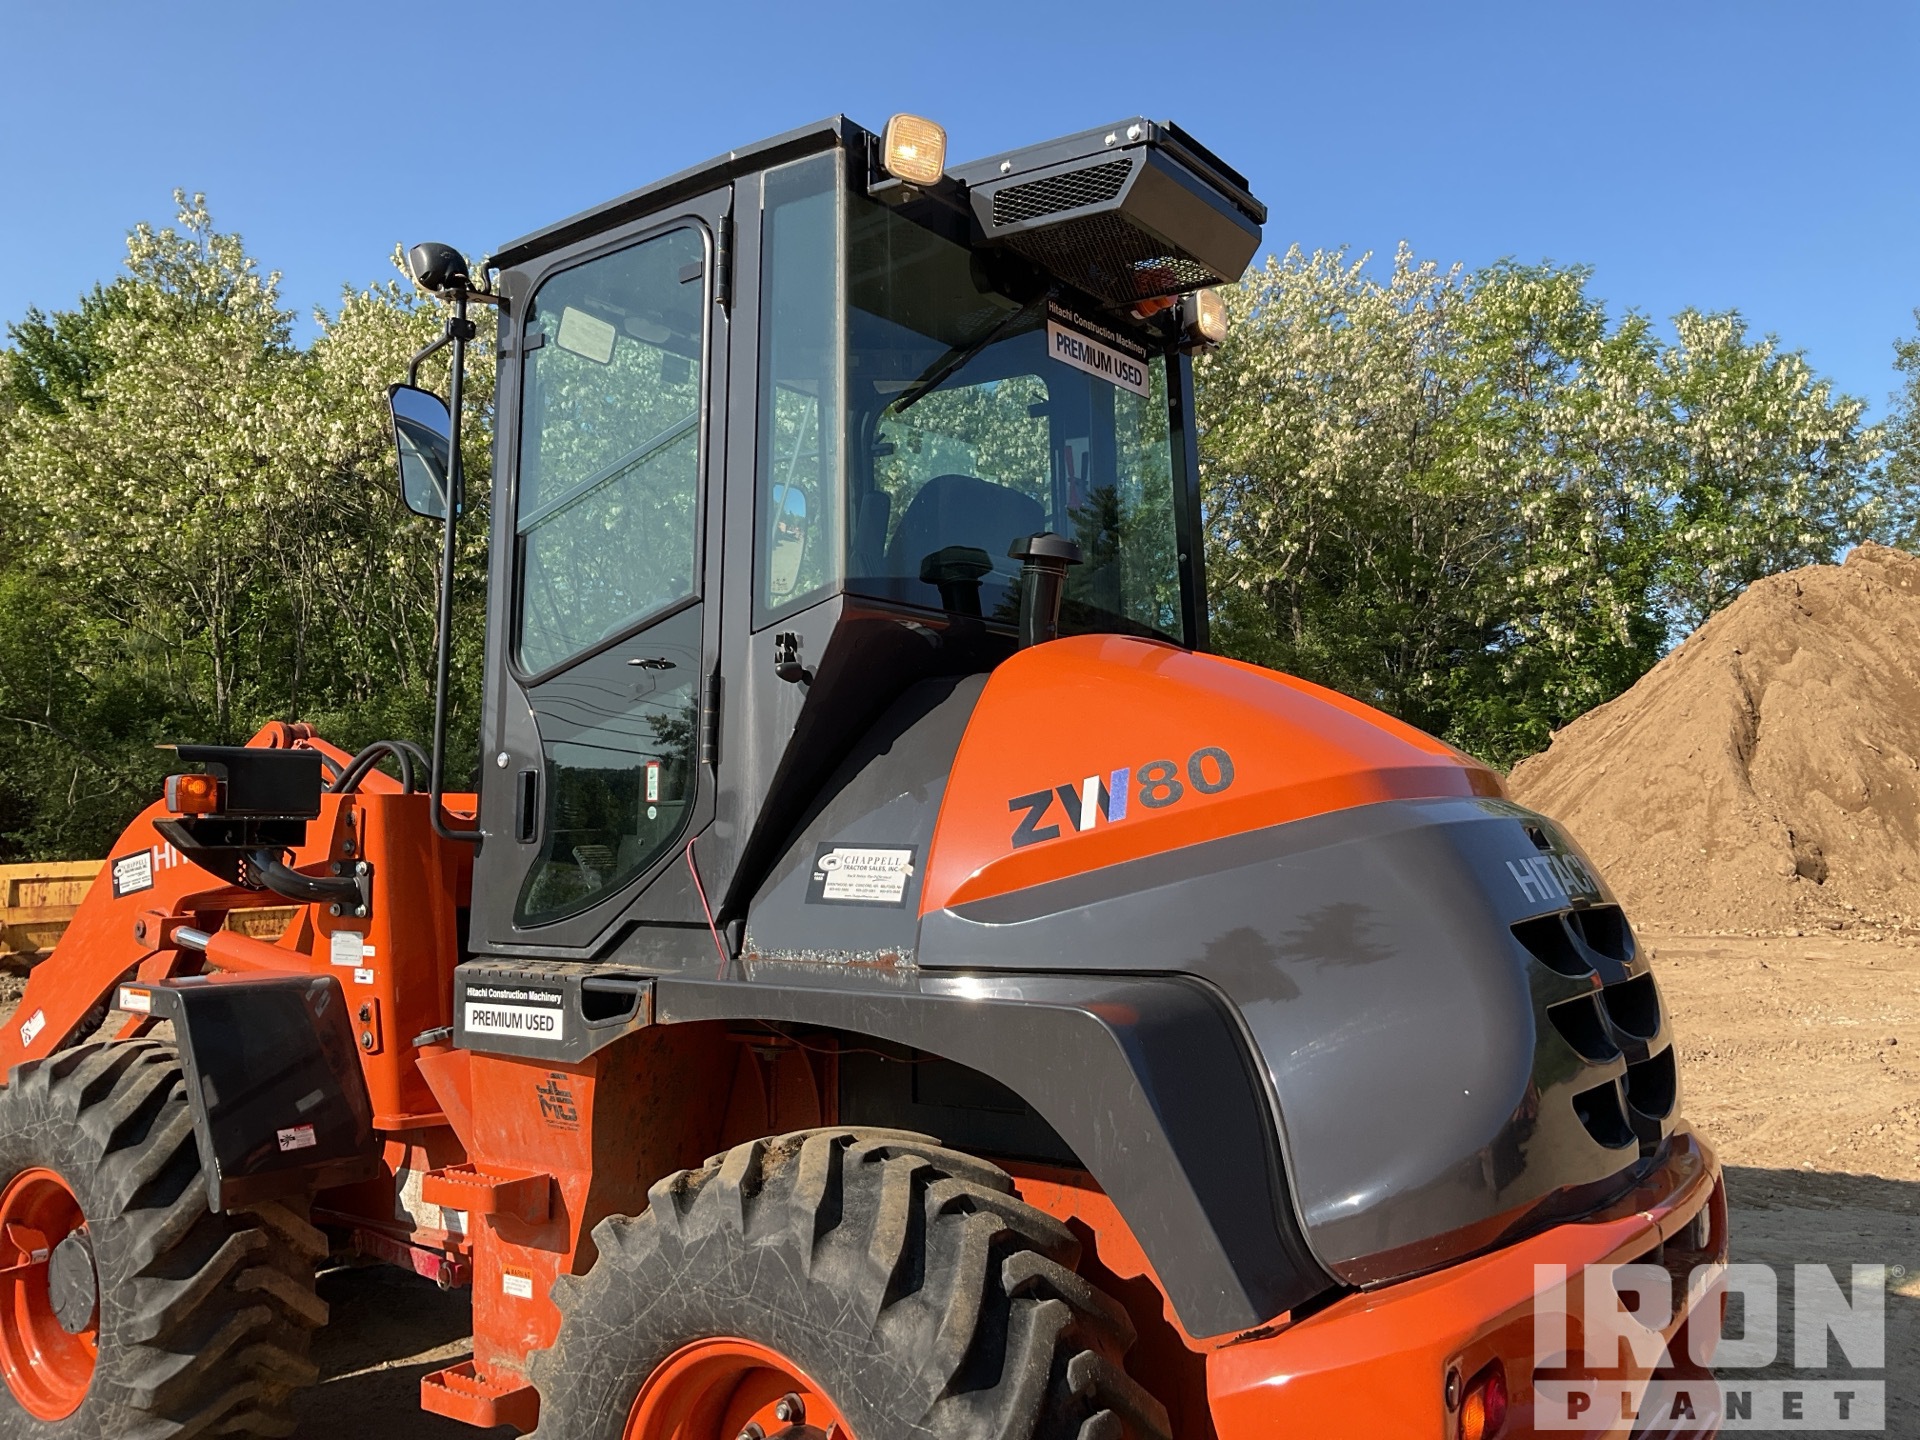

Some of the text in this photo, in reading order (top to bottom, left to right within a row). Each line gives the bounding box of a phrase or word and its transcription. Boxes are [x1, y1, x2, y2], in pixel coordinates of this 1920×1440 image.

[1048, 300, 1147, 359] Hitachi Construction Machinery
[1056, 331, 1142, 387] PREMIUM USED
[843, 864, 868, 872] TRACTOR
[844, 855, 902, 867] CHAPPELL
[1505, 853, 1601, 903] HITACH
[466, 987, 562, 1005] Hitachi Construction Machinery
[472, 1009, 555, 1032] PREMIUM USED
